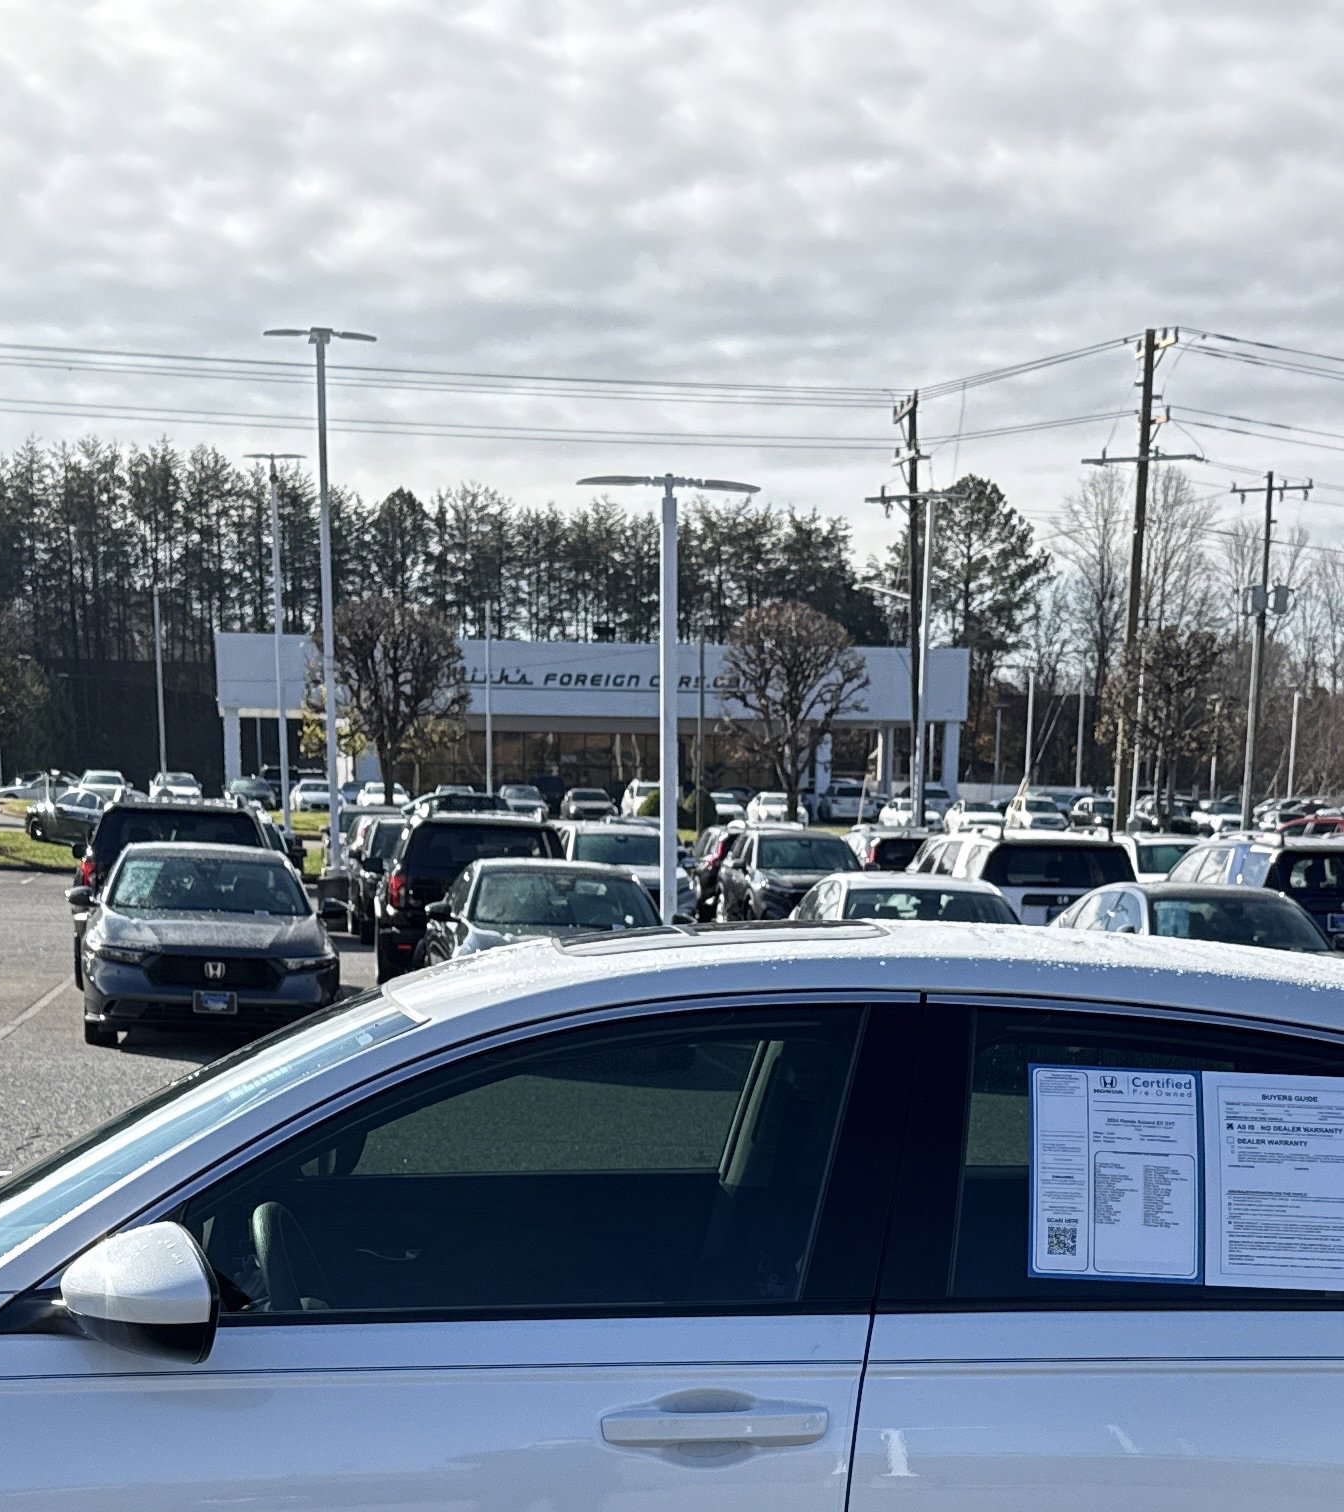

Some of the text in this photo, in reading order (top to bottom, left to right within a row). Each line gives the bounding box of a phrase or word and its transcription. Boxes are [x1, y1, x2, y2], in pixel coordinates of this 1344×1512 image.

[452, 665, 534, 686] ick's
[543, 672, 641, 688] FOREIGN
[1131, 1076, 1192, 1089] Certified
[1261, 1093, 1293, 1102] BUYERS
[1236, 1137, 1309, 1147] DEALER WARRANTY
